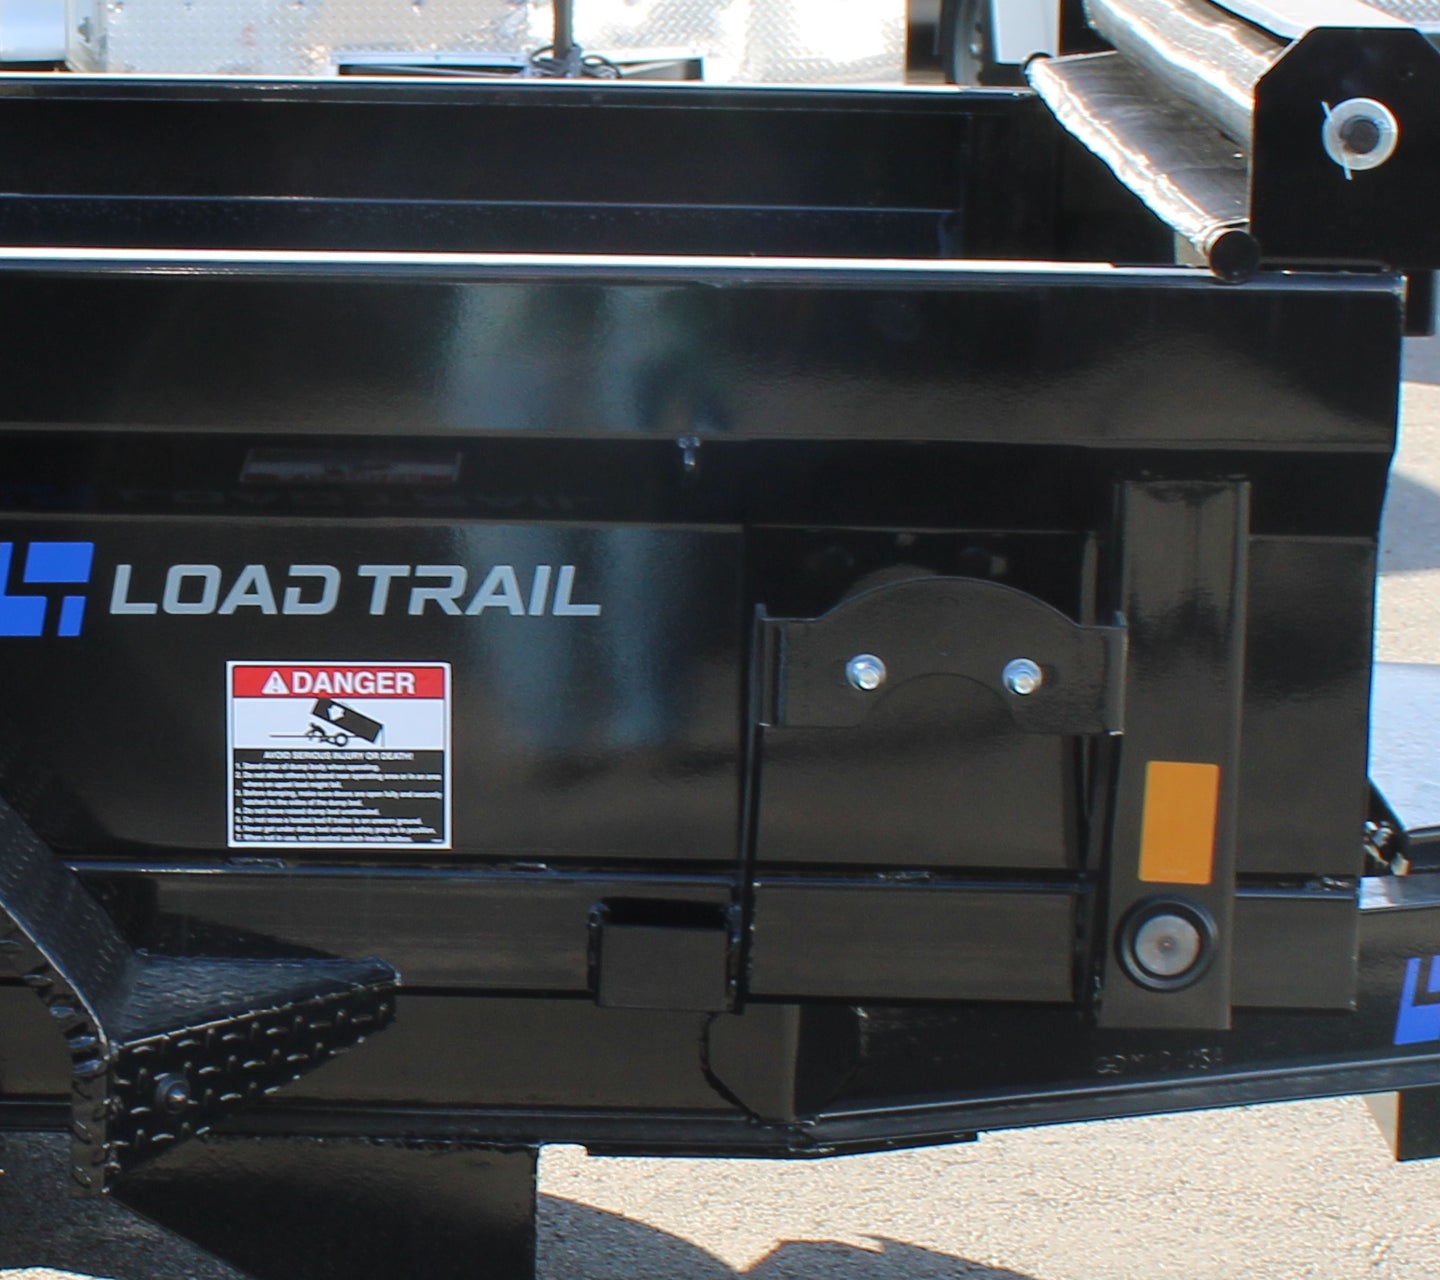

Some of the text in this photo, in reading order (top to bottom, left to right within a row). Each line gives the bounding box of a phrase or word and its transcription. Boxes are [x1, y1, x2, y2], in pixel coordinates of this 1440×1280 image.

[109, 563, 603, 617] LOAD TRAIL
[291, 671, 417, 695] DANGER
